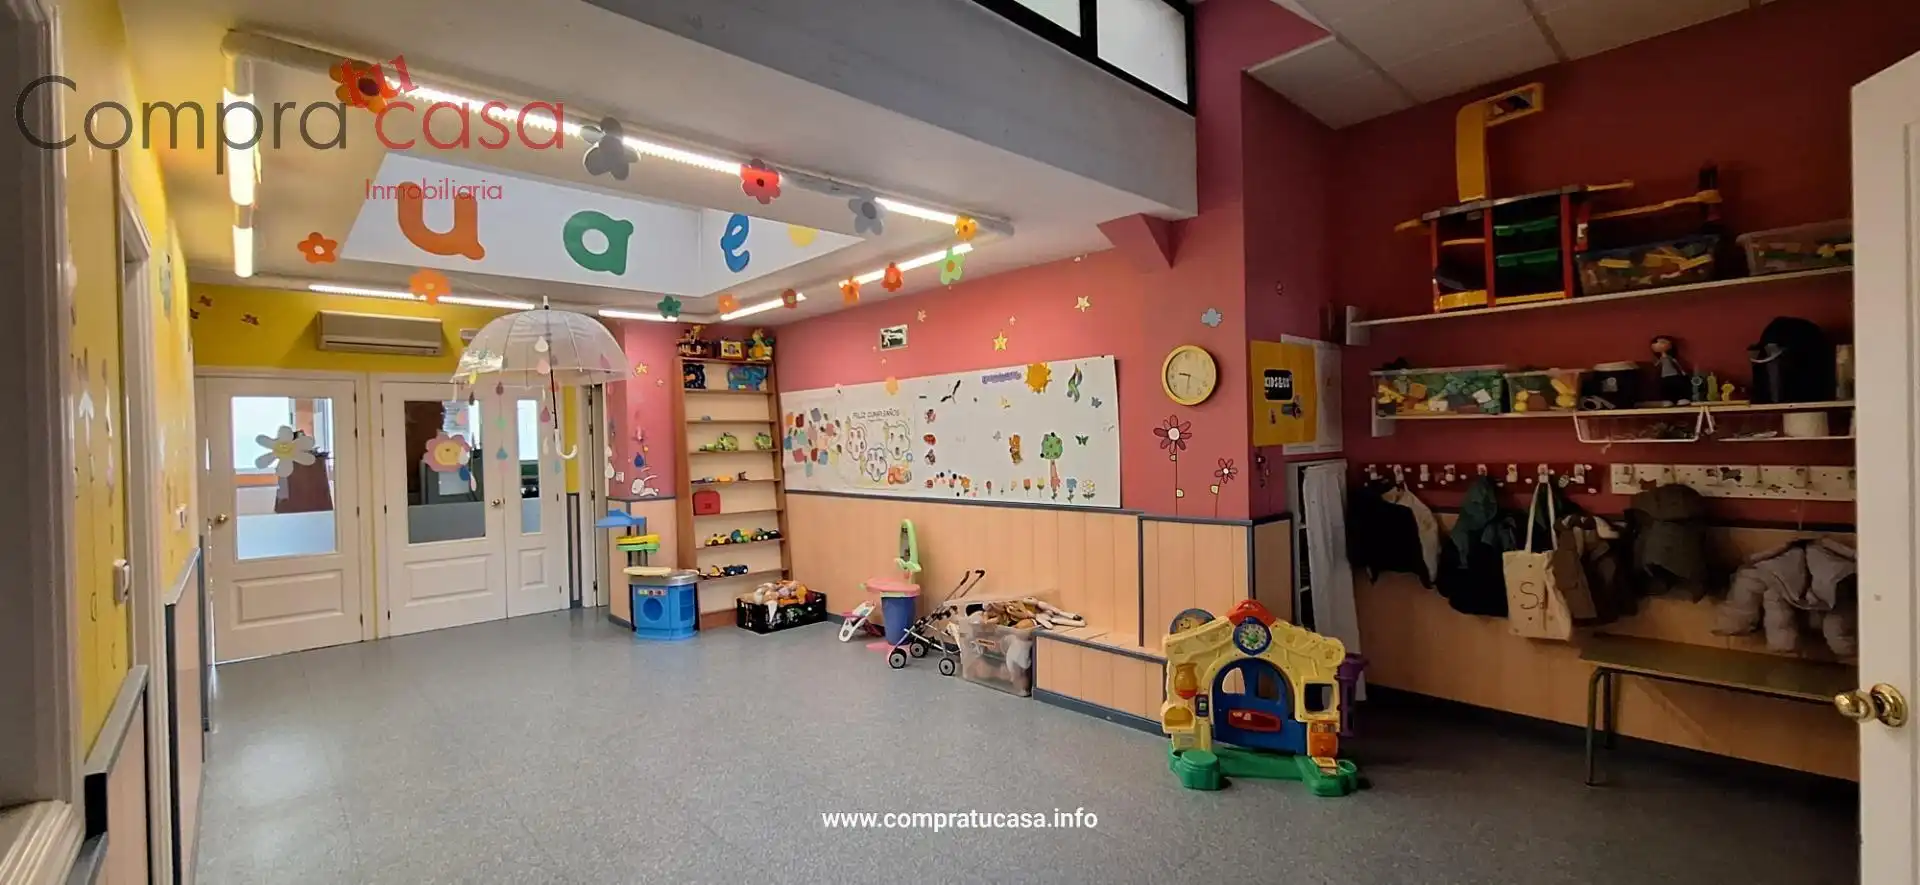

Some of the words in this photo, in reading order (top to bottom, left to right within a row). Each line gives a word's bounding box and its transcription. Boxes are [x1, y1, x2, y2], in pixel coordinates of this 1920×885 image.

[398, 182, 485, 260] u
[563, 210, 634, 276] a
[720, 213, 750, 273] e
